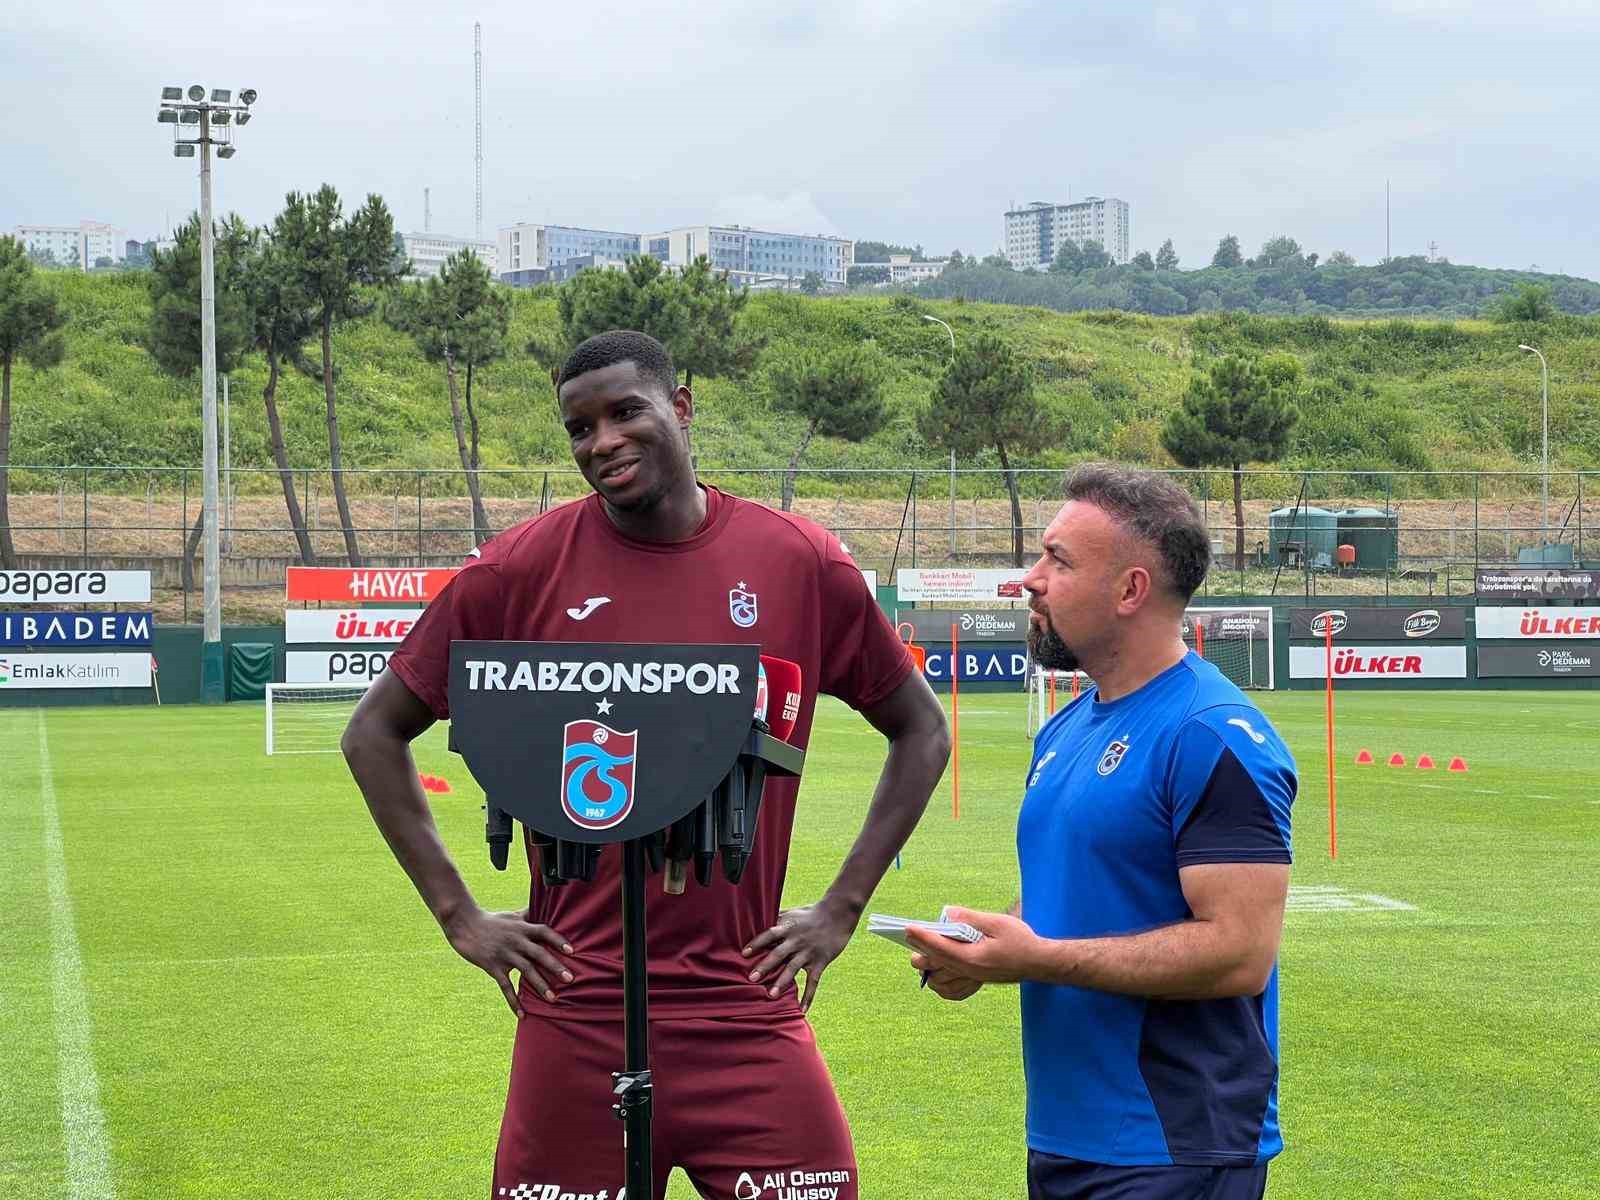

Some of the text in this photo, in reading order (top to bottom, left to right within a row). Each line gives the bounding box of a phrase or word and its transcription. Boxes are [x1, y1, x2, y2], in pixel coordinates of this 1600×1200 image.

[352, 571, 428, 598] HAYAT
[976, 621, 1016, 629] DEDEMAN
[1335, 648, 1423, 675] ÜLKER
[1552, 657, 1591, 665] DEDEMAN
[465, 660, 741, 695] TRABZONSPOR
[763, 1170, 850, 1190] Ali Osman
[777, 1187, 839, 1200] Ulusoy
